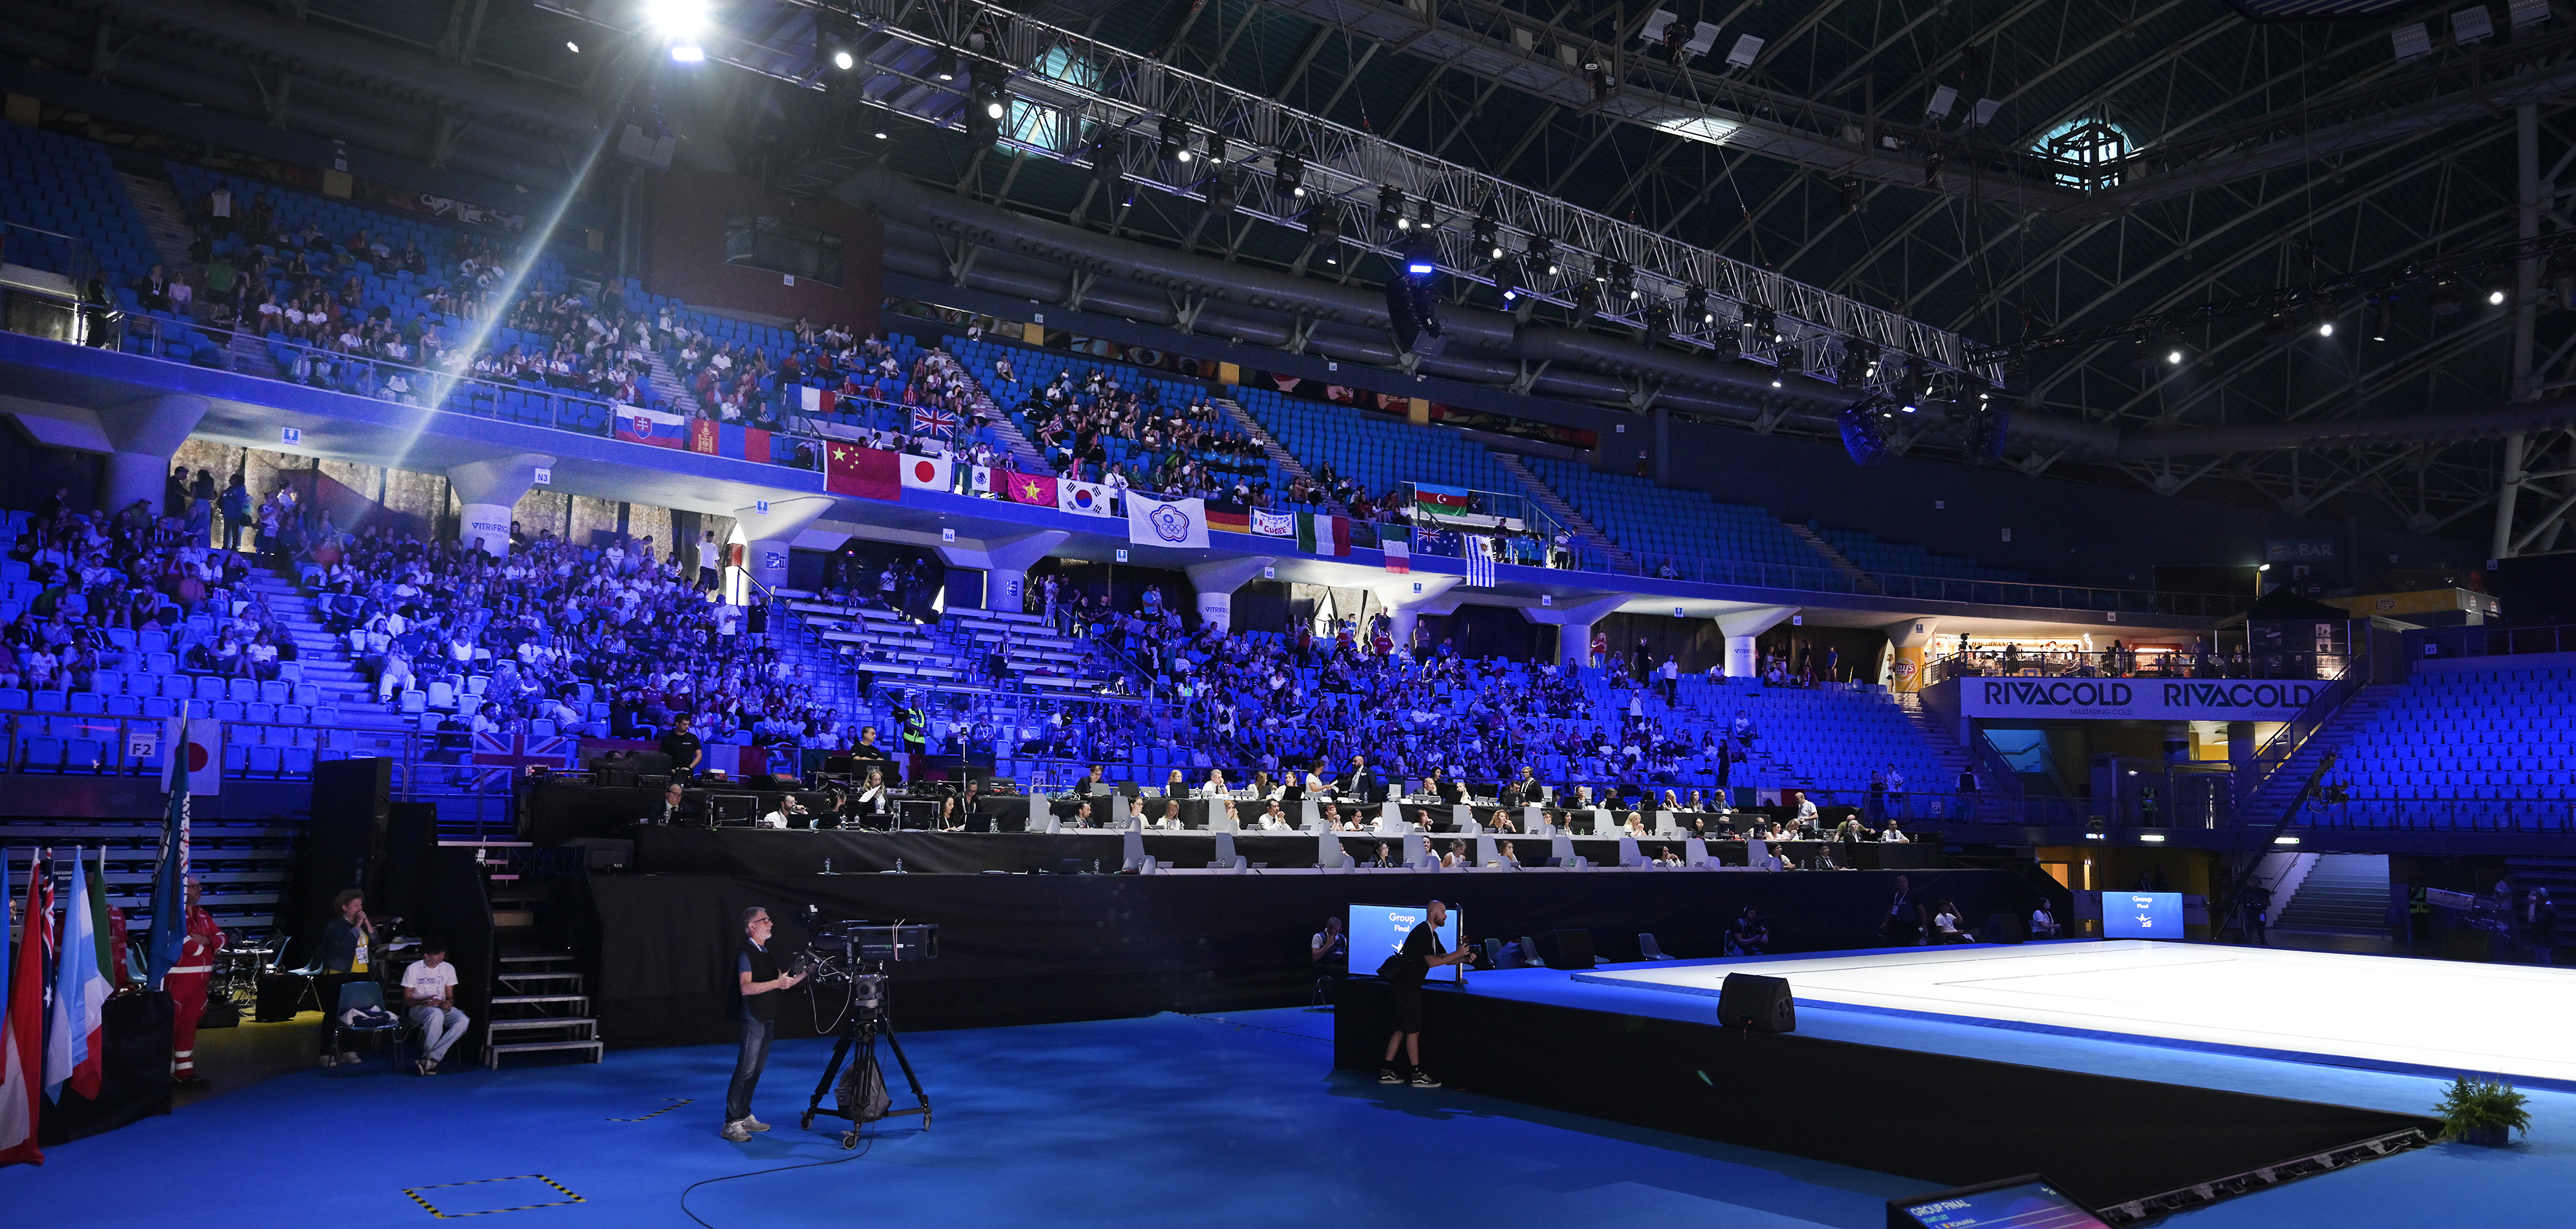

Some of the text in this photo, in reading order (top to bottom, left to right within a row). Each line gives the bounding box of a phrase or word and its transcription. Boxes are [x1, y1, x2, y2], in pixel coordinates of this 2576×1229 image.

[537, 473, 548, 482] N3
[2299, 543, 2333, 556] BAR
[780, 557, 785, 567] 11
[1984, 681, 2314, 708] RIVACOLD RIVACOLD
[132, 743, 152, 756] F2
[2132, 895, 2153, 904] Group
[1389, 912, 1416, 925] Group
[1910, 1198, 1972, 1217] GROUP FINAL
